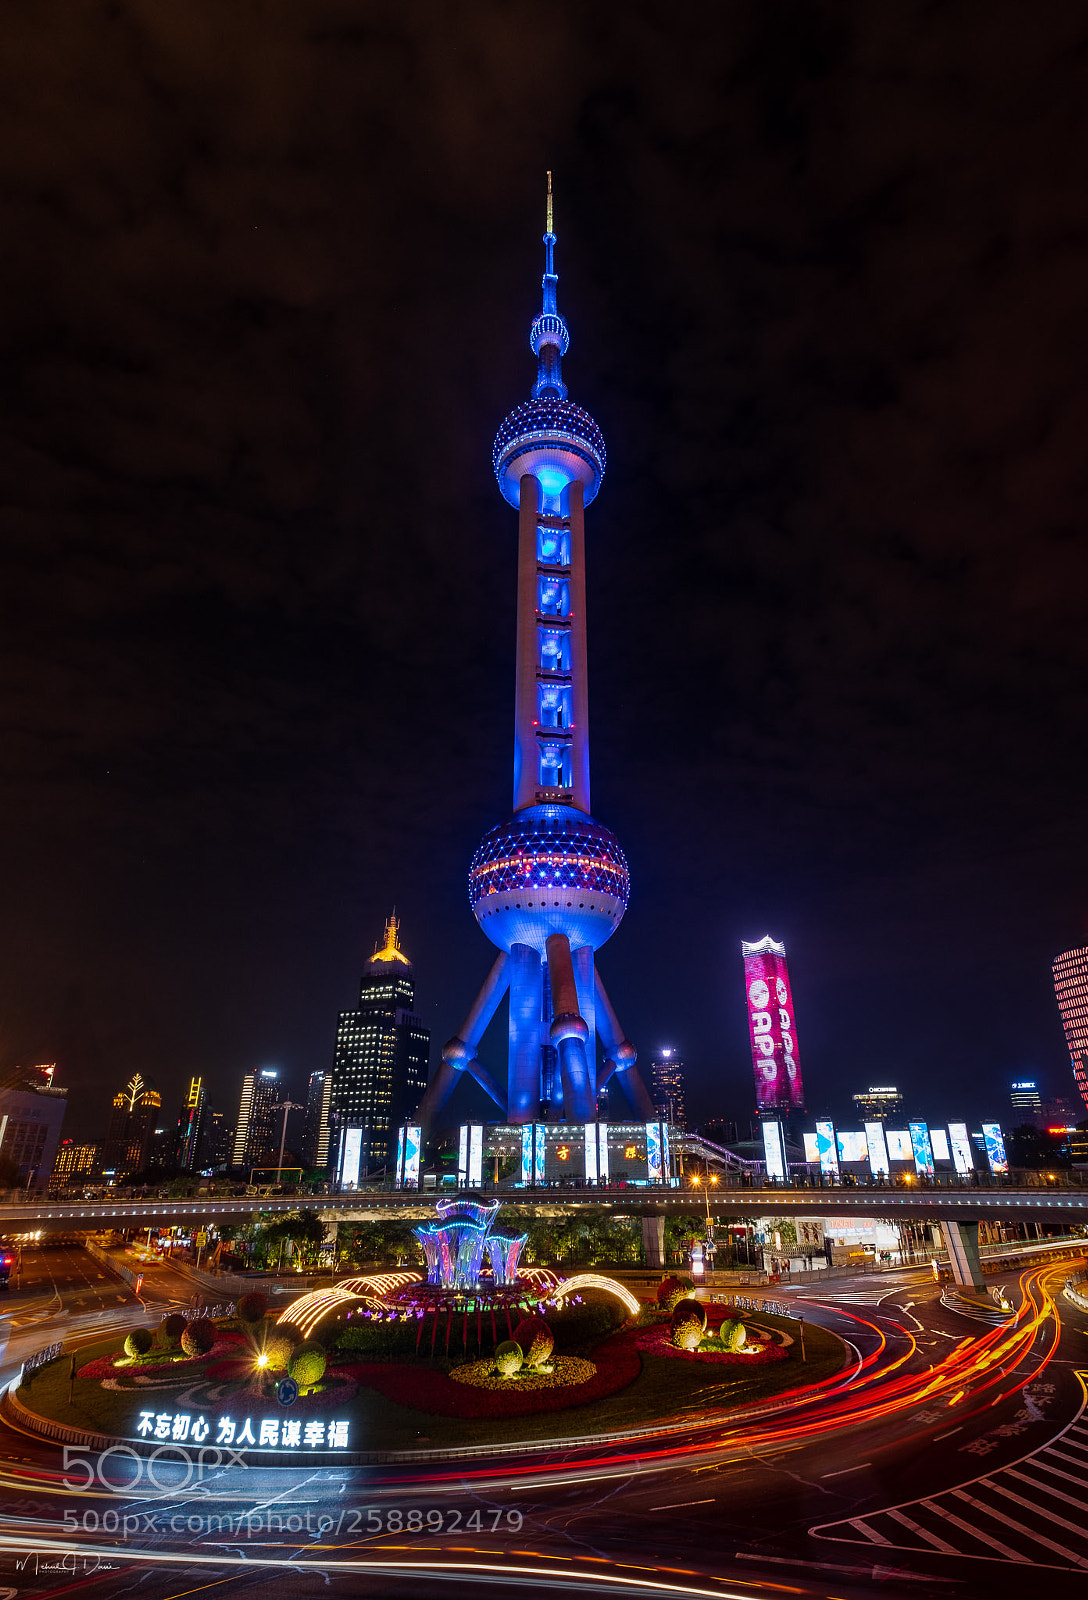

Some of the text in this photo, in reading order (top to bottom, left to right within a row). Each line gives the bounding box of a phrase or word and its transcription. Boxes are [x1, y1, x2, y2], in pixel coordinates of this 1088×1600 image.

[557, 1145, 569, 1160] 方
[137, 1411, 350, 1448] 不忘初心 为人民谋幸福
